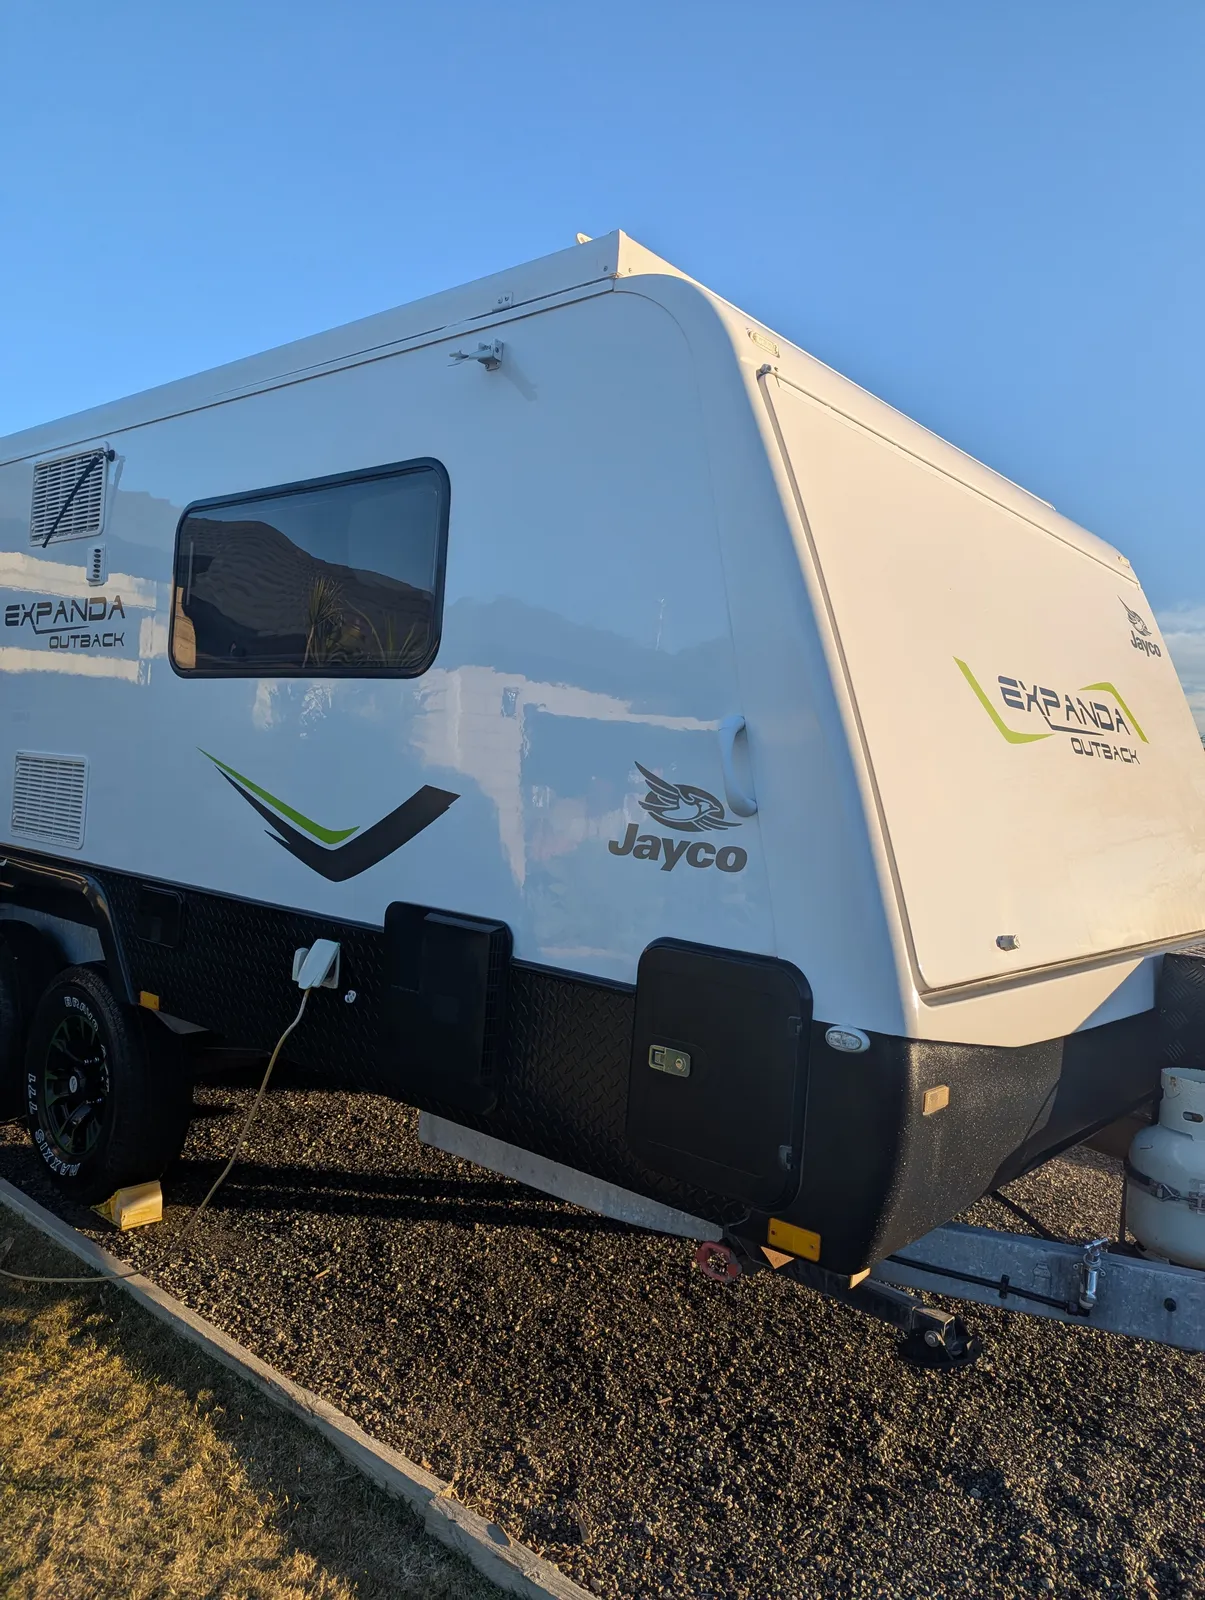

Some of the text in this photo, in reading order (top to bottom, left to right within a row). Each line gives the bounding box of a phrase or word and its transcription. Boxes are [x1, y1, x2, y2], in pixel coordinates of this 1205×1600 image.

[4, 595, 126, 627] EXPANDA
[49, 632, 125, 649] OUTBACK
[1130, 630, 1162, 658] Jayco
[997, 675, 1131, 735] EXPANDA
[1070, 737, 1141, 765] OUTBACK
[608, 822, 748, 873] Jayco
[63, 996, 99, 1032] BRAVO
[34, 1128, 81, 1177] MAXXIS
